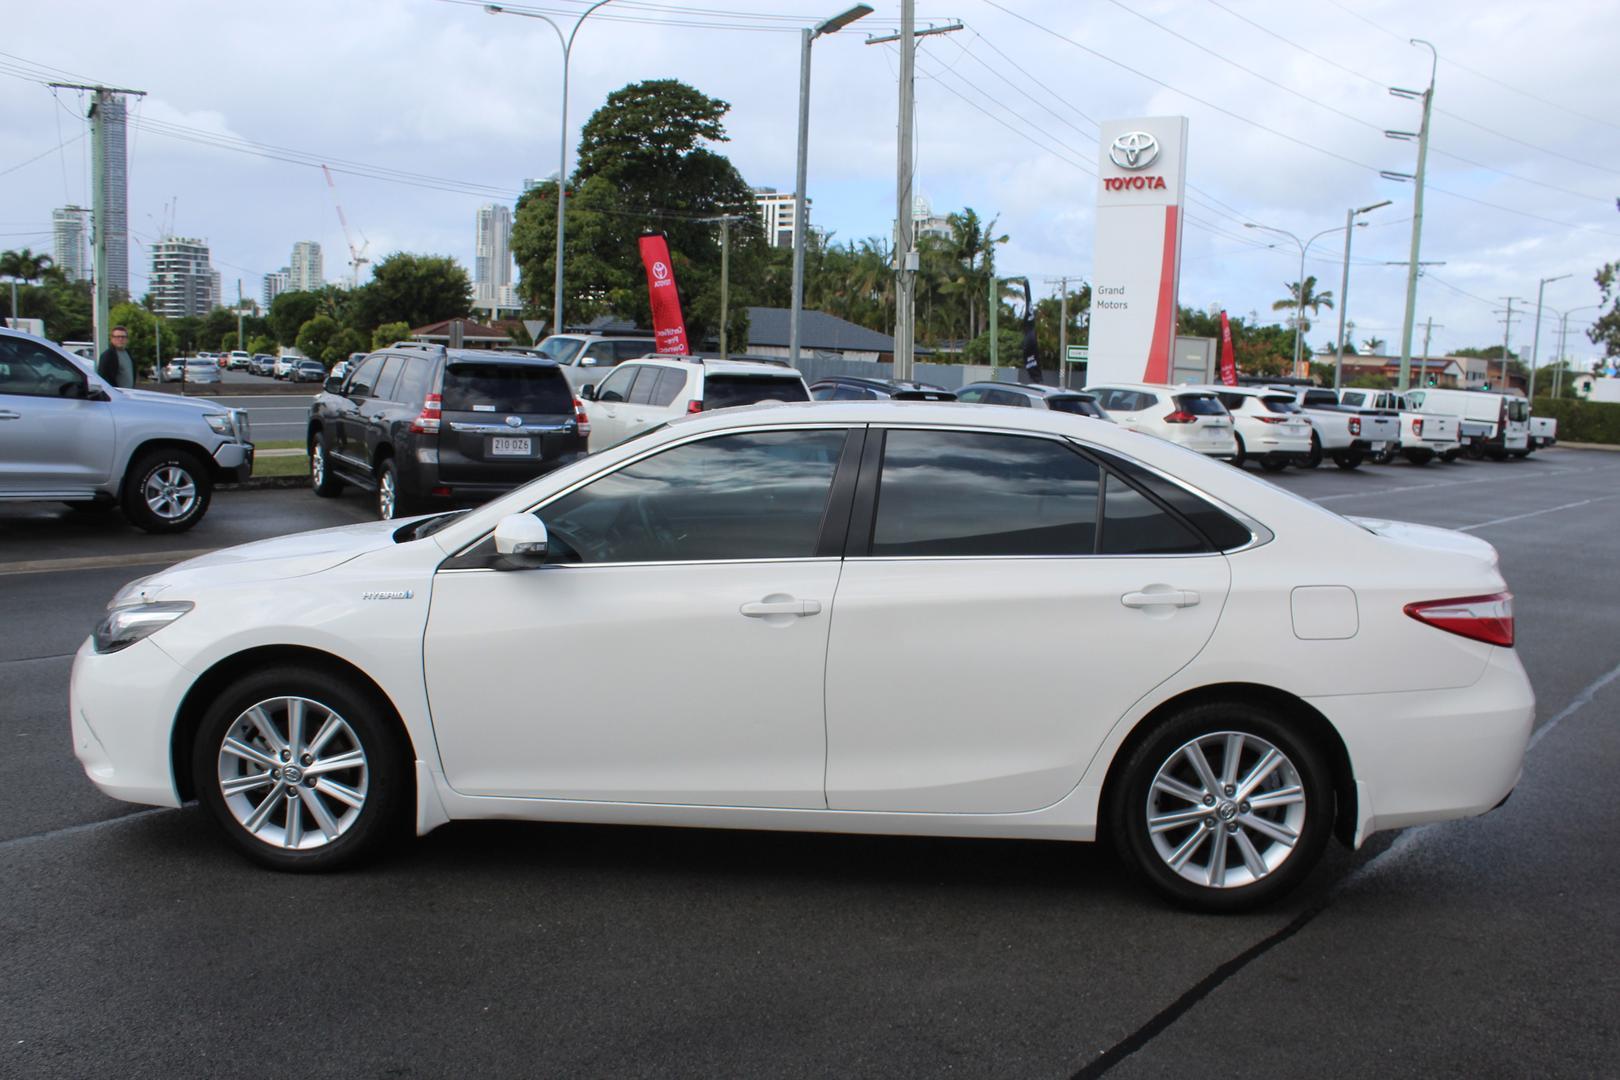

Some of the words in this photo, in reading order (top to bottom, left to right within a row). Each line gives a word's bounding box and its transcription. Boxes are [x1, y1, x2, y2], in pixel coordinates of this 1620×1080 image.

[1103, 176, 1167, 191] TOYOTA
[1098, 285, 1125, 295] Grand
[1097, 300, 1128, 309] Motors
[360, 591, 405, 600] HYBRID
